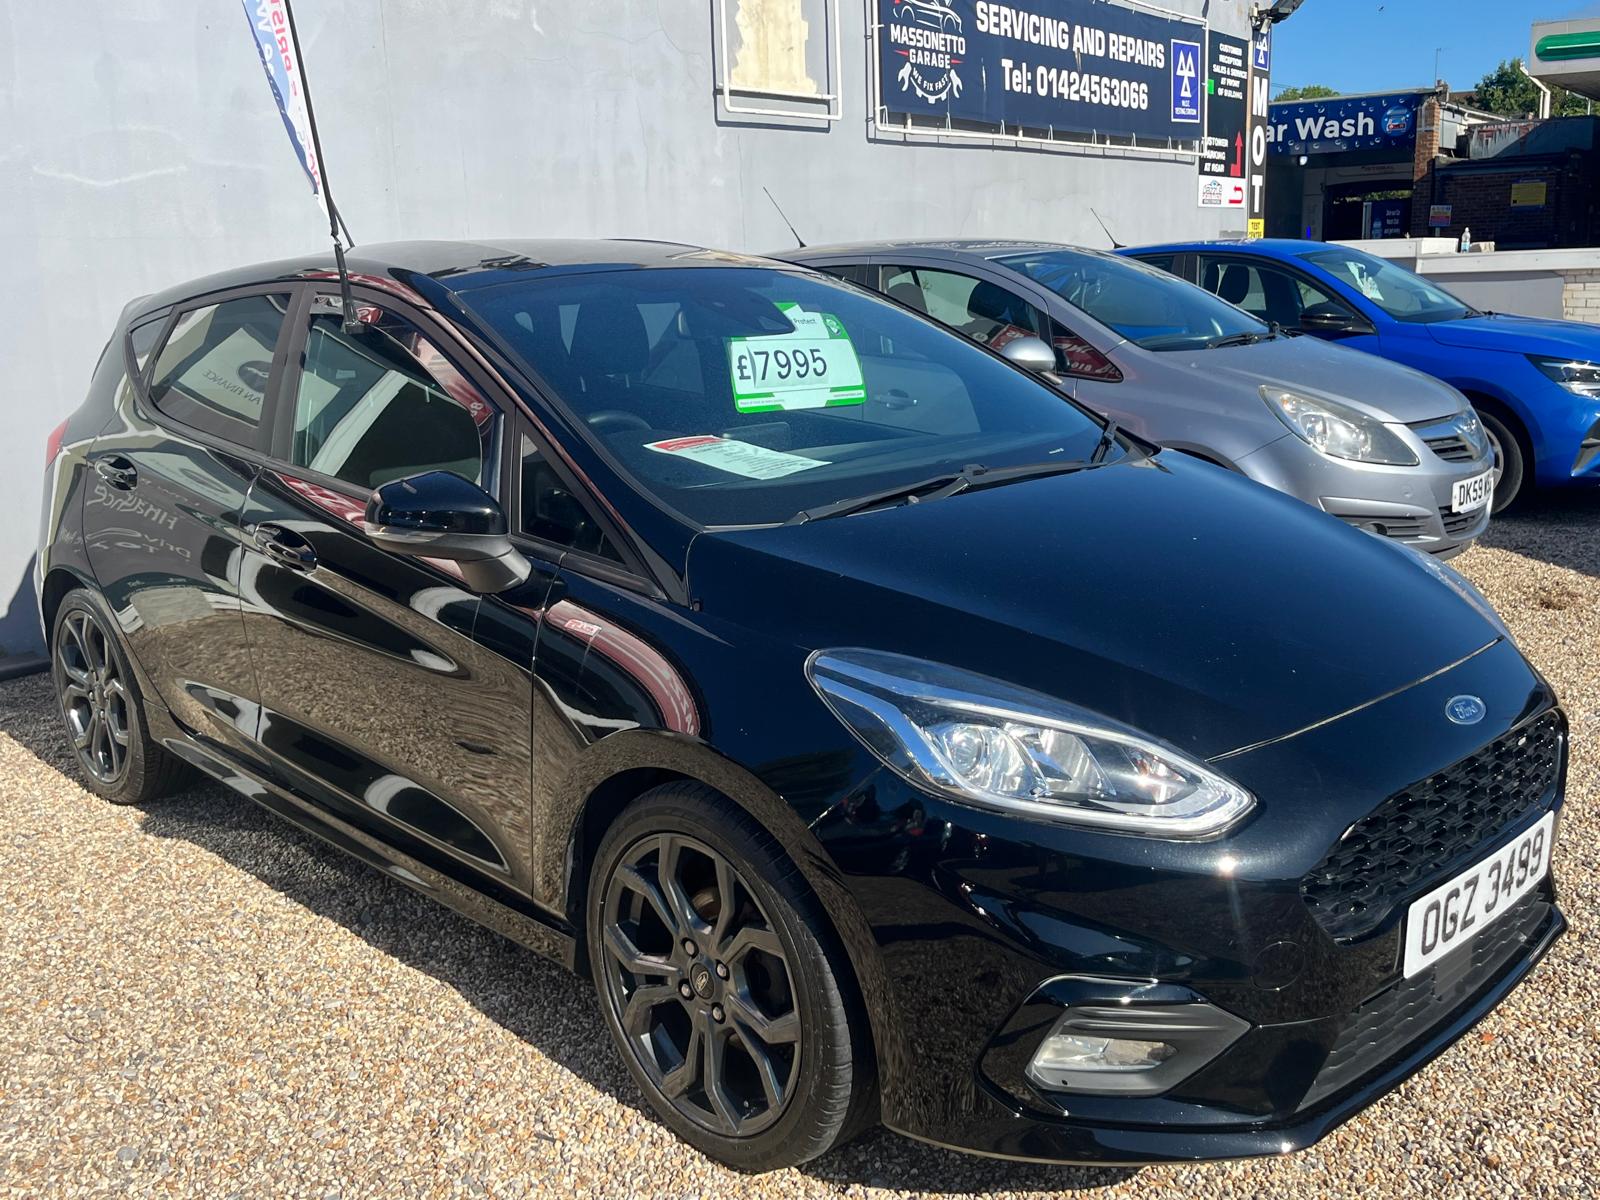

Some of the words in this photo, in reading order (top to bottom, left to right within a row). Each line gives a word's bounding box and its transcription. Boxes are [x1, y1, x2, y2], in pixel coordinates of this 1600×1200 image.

[890, 23, 966, 55] MASSONETTO
[976, 1, 1069, 49] SERVICING
[1073, 25, 1106, 57] AND
[1109, 33, 1165, 69] REPAIRS
[909, 49, 951, 69] GARAGE
[912, 67, 922, 85] WE
[923, 80, 933, 91] FIX
[935, 73, 948, 91] FAST
[1001, 58, 1031, 94] Tel:
[1036, 65, 1148, 110] 01424563066
[1266, 123, 1288, 143] ar
[1295, 111, 1374, 140] Wash
[1421, 872, 1480, 957] OGZ
[1485, 826, 1545, 915] 3499
